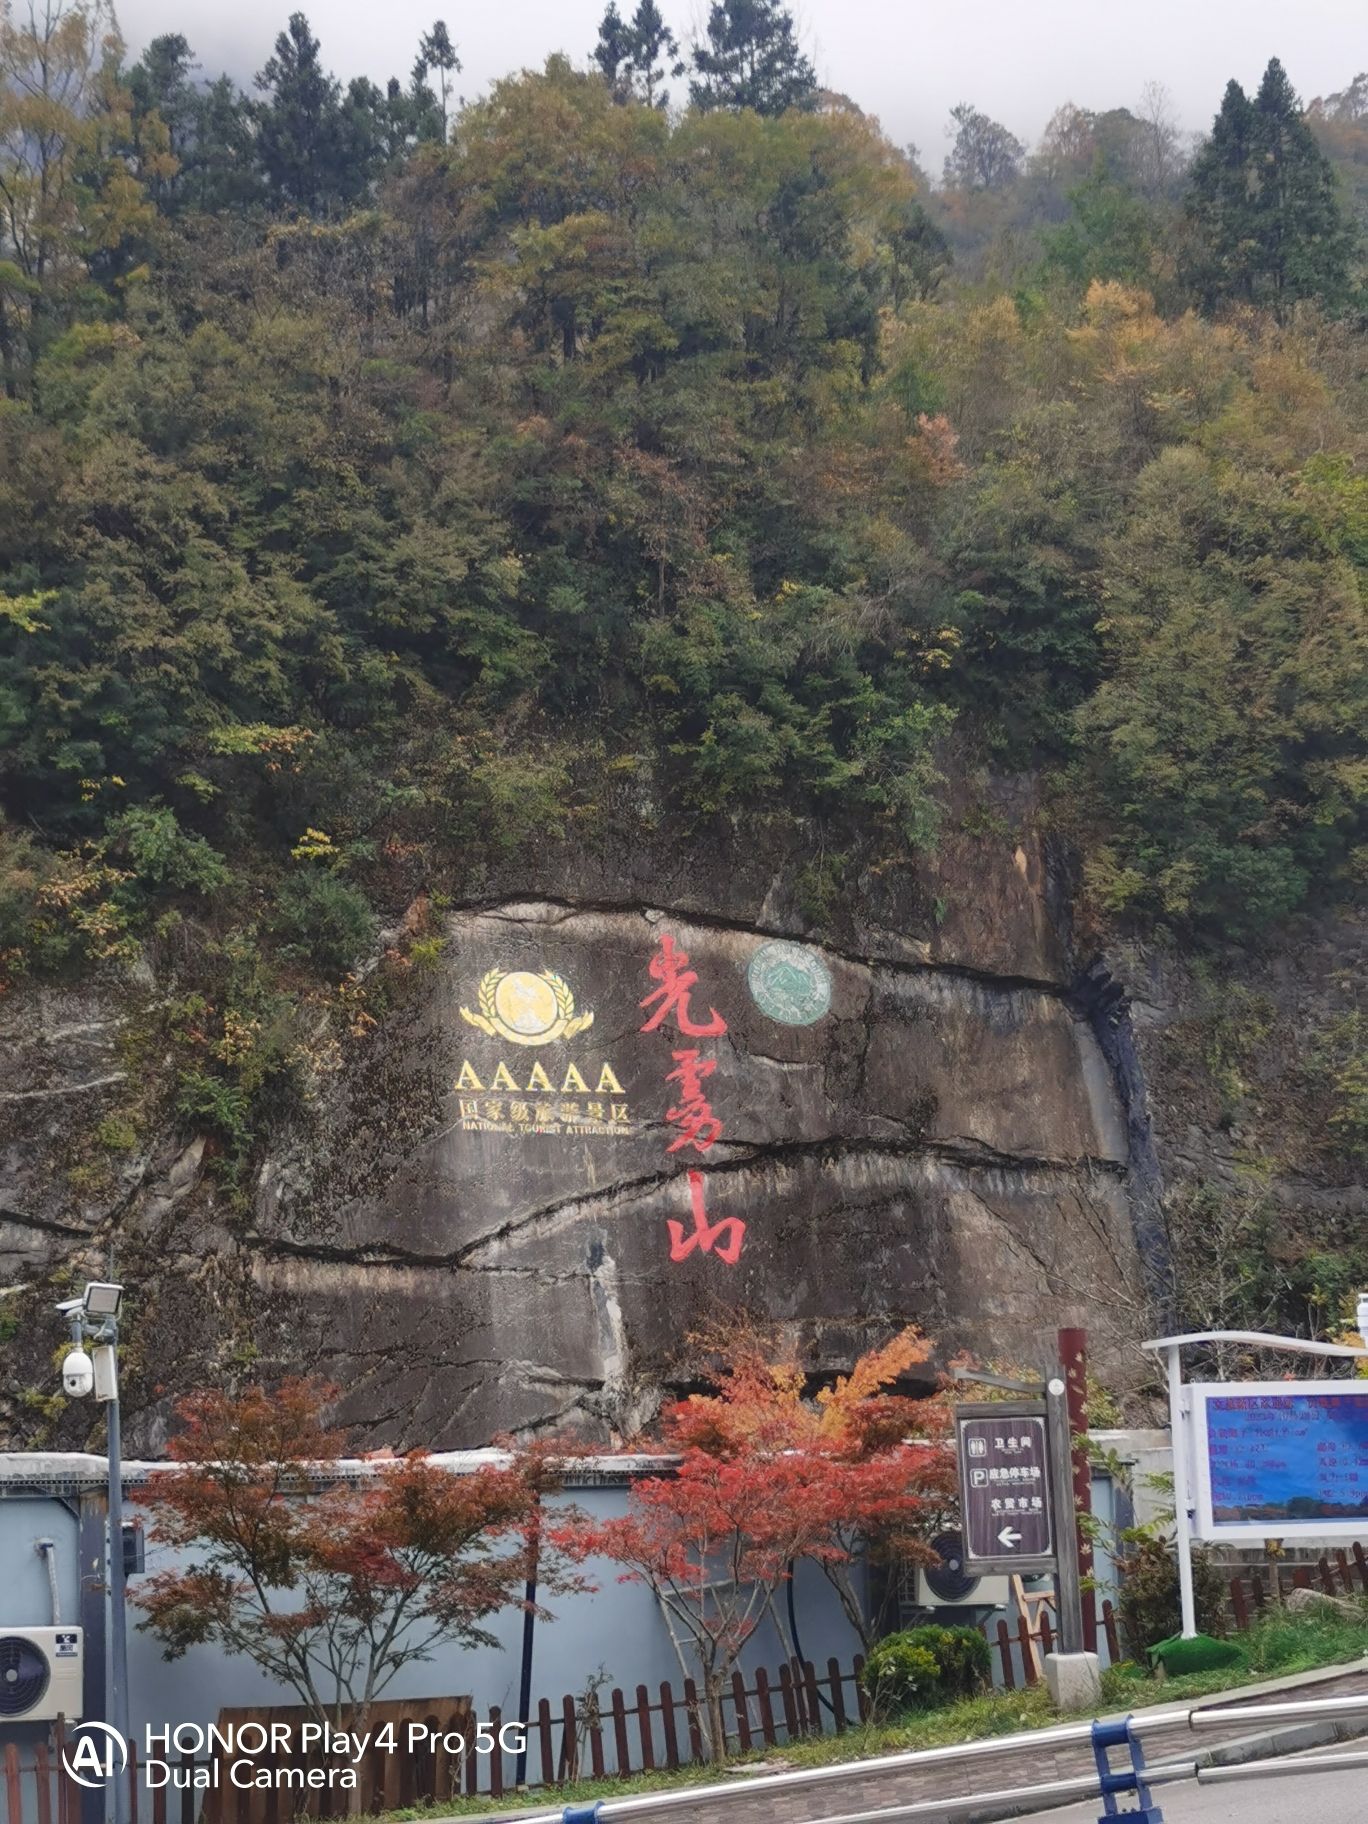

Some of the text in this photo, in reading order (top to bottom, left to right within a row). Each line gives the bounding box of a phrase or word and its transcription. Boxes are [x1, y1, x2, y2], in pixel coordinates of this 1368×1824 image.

[455, 1059, 626, 1094] AAAAA
[459, 1099, 631, 1125] 国家级旅游景区
[463, 1120, 630, 1136] NATIONAL TOURIST ATTRACTION
[994, 1436, 1032, 1448] 卫生间
[973, 1470, 984, 1484] P
[989, 1466, 1041, 1480] 应急停车场
[991, 1496, 1042, 1511] 农贸市场
